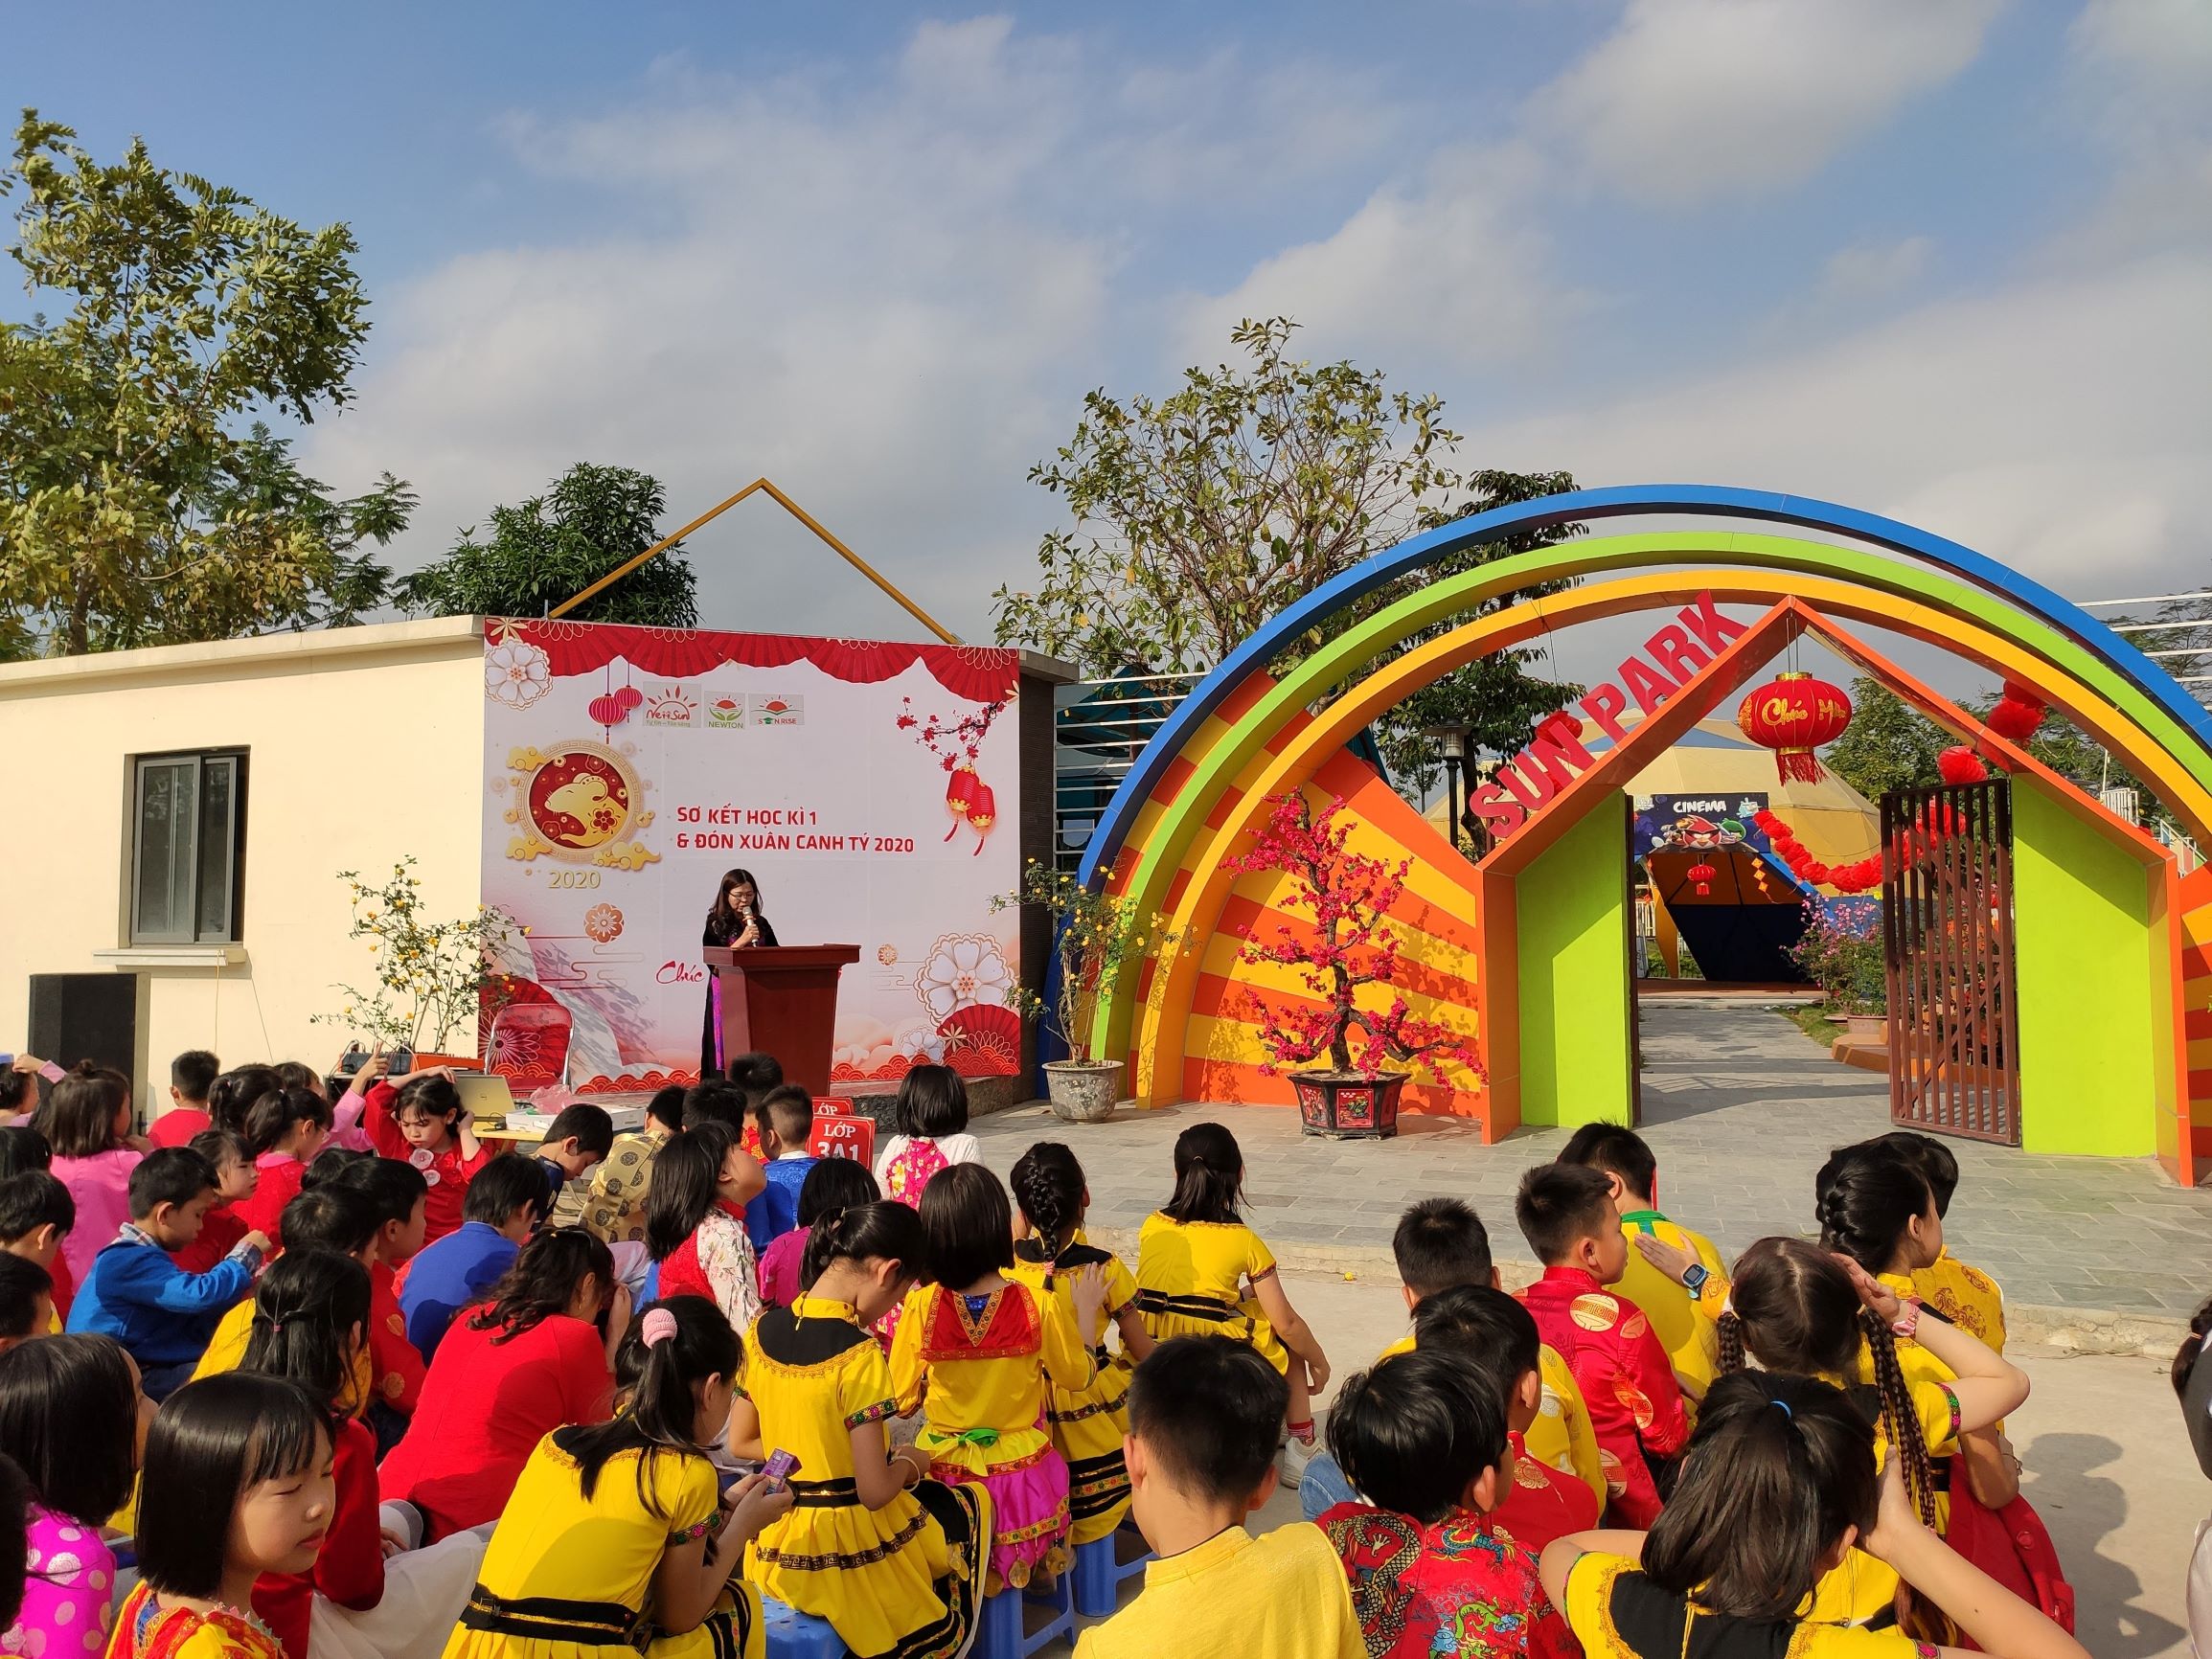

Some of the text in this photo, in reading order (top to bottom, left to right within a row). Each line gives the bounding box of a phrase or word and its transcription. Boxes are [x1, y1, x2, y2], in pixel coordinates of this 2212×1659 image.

[1470, 588, 1749, 838] SUN PARK
[676, 803, 817, 829] SƠ KẾT HỌC KÌ 1
[1673, 801, 1727, 813] CINEMA
[676, 830, 915, 852] & ĐÓN XUÂN CANH TÝ 2020
[547, 870, 602, 890] 2020
[656, 961, 705, 985] Chúc
[824, 1121, 856, 1138] LỚP
